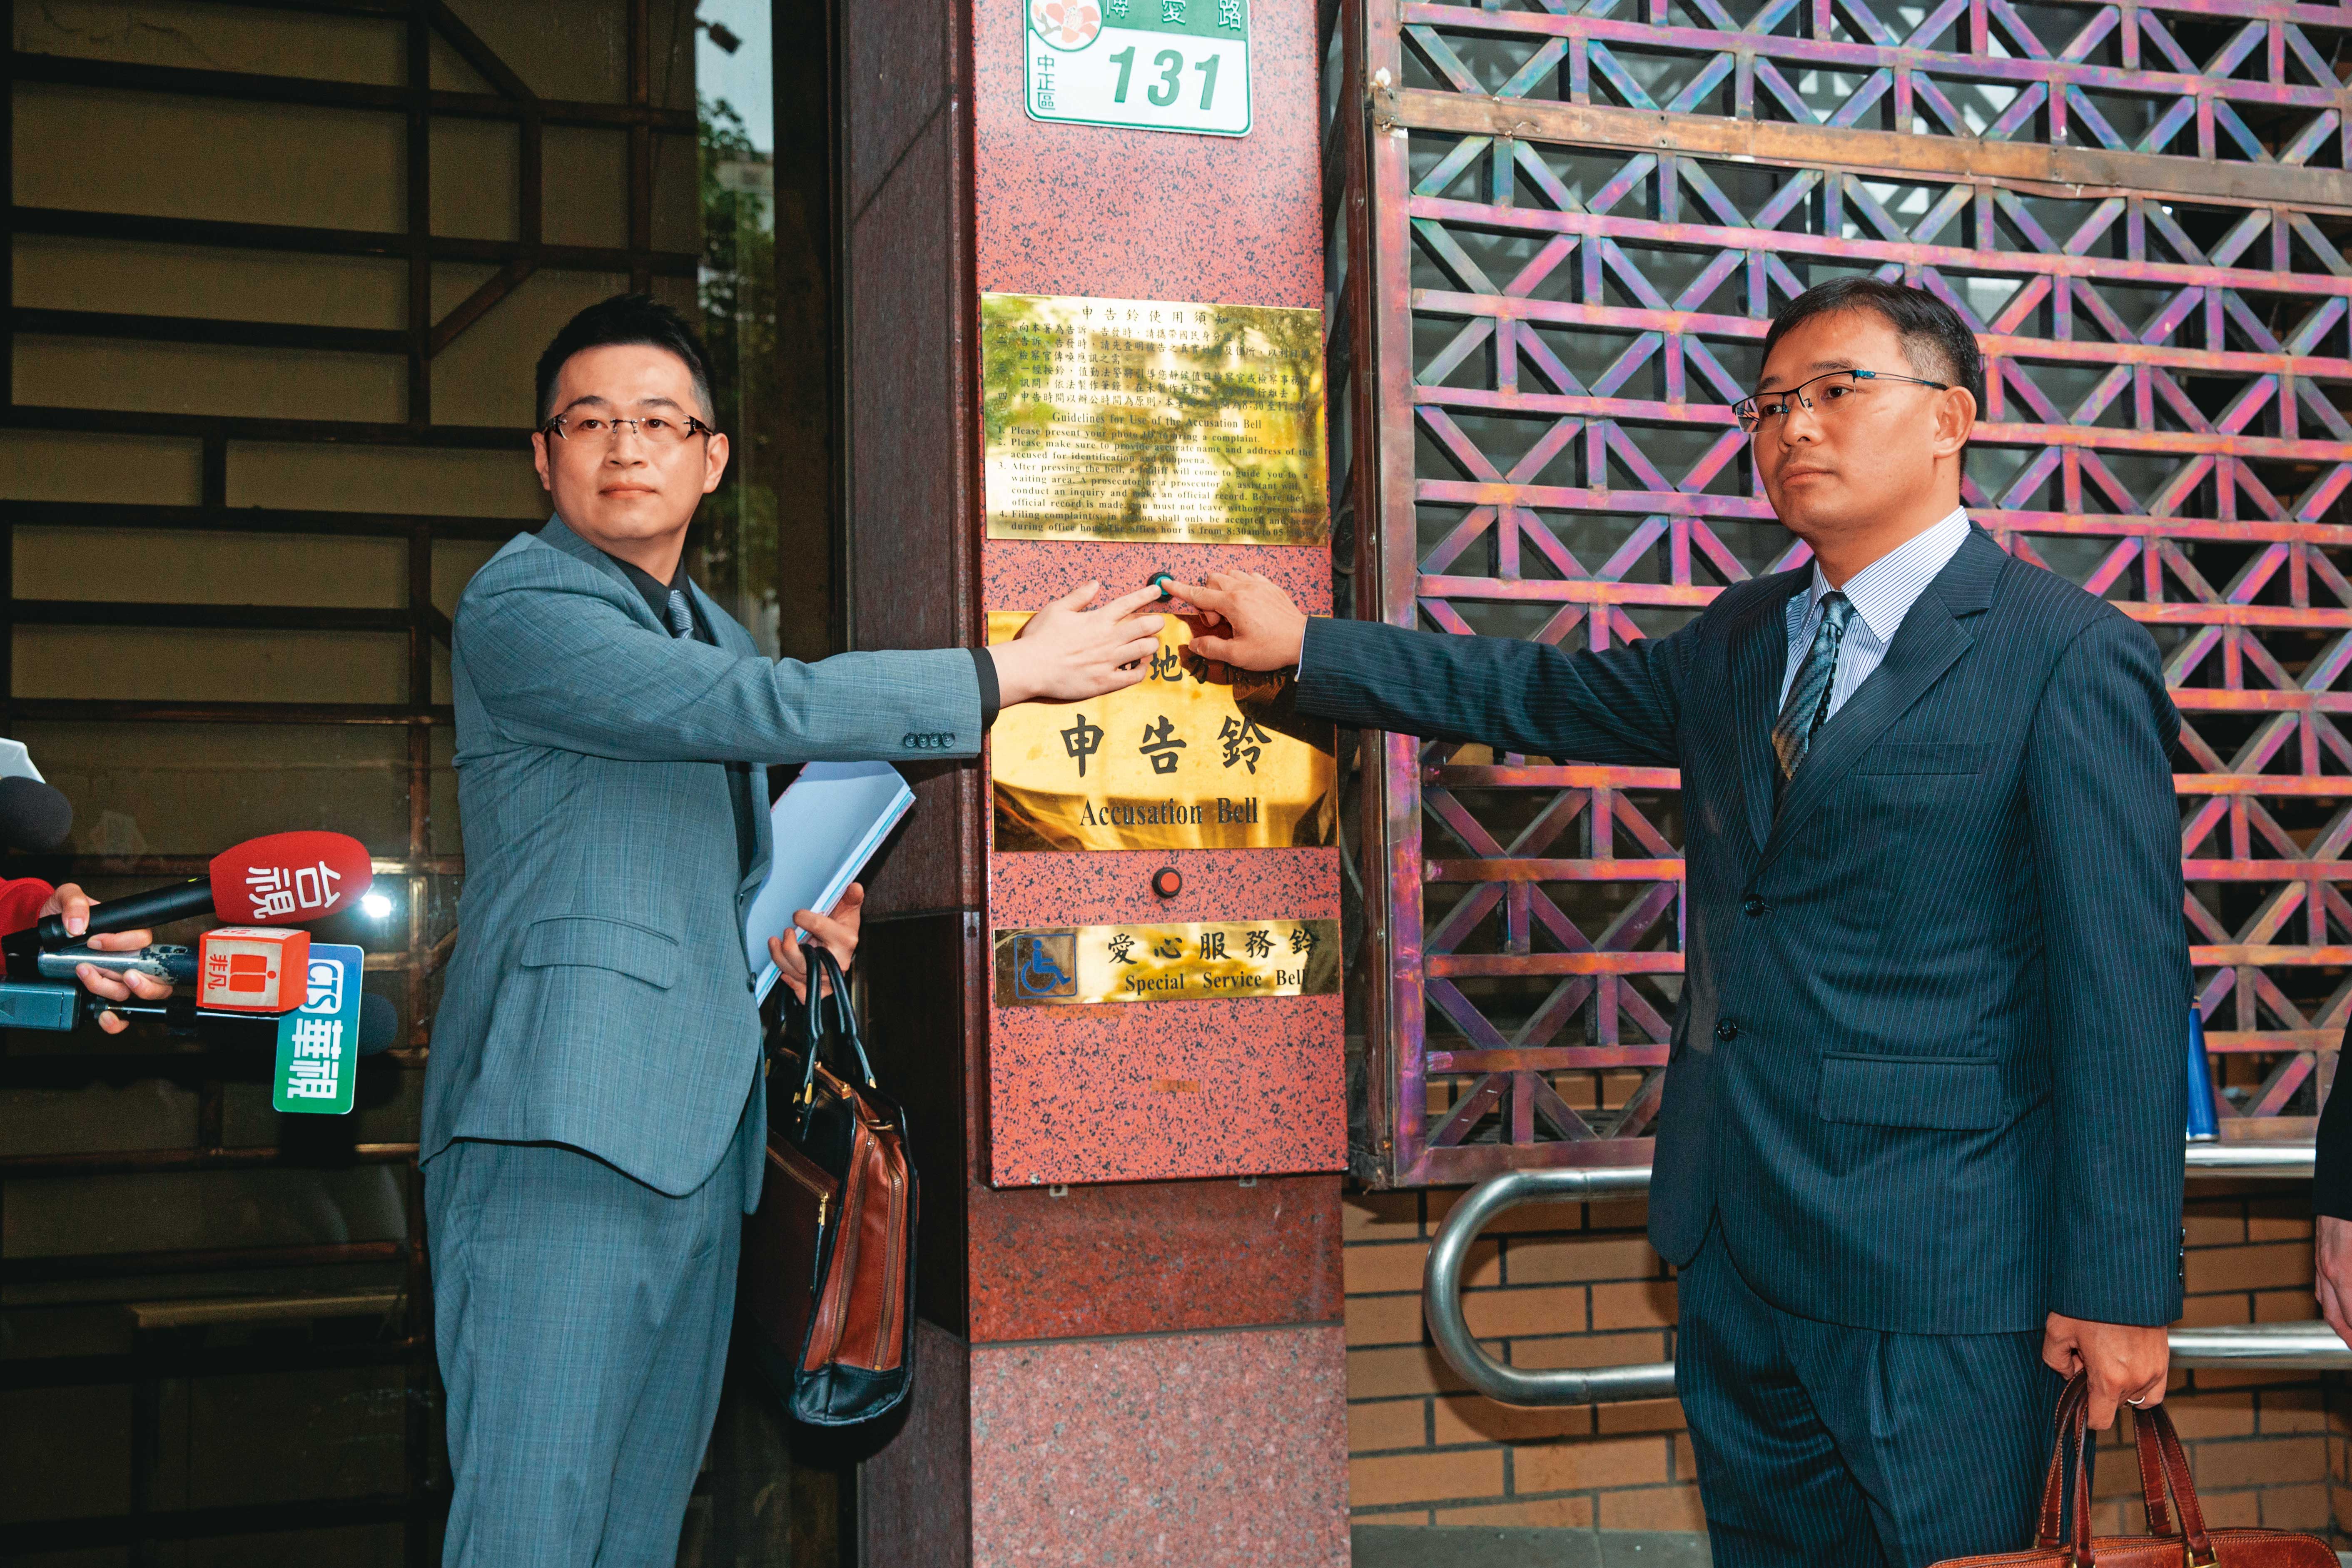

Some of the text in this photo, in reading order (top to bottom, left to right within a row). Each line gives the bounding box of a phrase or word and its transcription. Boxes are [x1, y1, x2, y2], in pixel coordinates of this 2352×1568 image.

[1037, 54, 1055, 110] 中正區
[1109, 46, 1220, 110] 131
[1082, 305, 1228, 325] 申告鈴使用須知
[1053, 412, 1261, 429] Guidelines for Use of the Accusation Bell
[1011, 426, 1040, 435] Please
[1111, 430, 1137, 439] photo
[1173, 432, 1197, 442] bring
[1213, 434, 1260, 443] complaint.
[1011, 438, 1040, 447] Please
[1115, 442, 1149, 451] provide
[1155, 443, 1194, 452] accurate
[1247, 446, 1281, 455] address
[1072, 452, 1134, 461] identification
[1041, 464, 1080, 474] pressing
[1086, 464, 1100, 473] the
[1105, 466, 1125, 474] bell,
[1236, 470, 1260, 479] guide
[1012, 475, 1046, 484] waiting
[1238, 481, 1276, 490] assistant
[1071, 489, 1105, 499] inquiry
[1012, 498, 1045, 506] official
[1051, 499, 1081, 508] record
[1228, 504, 1263, 513] without
[1012, 510, 1039, 520] Filing
[1044, 512, 1102, 520] complaint(s)
[1012, 522, 1043, 532] during
[1049, 523, 1075, 531] office
[1060, 714, 1272, 778] 申告鈴
[1079, 797, 1258, 826] Accusation Bell
[246, 860, 341, 919] 台視
[1108, 928, 1321, 965] 愛心服務鈴
[208, 954, 228, 990] 非凡
[1125, 969, 1306, 996] Special Service Bell
[287, 1018, 343, 1099] 華視
